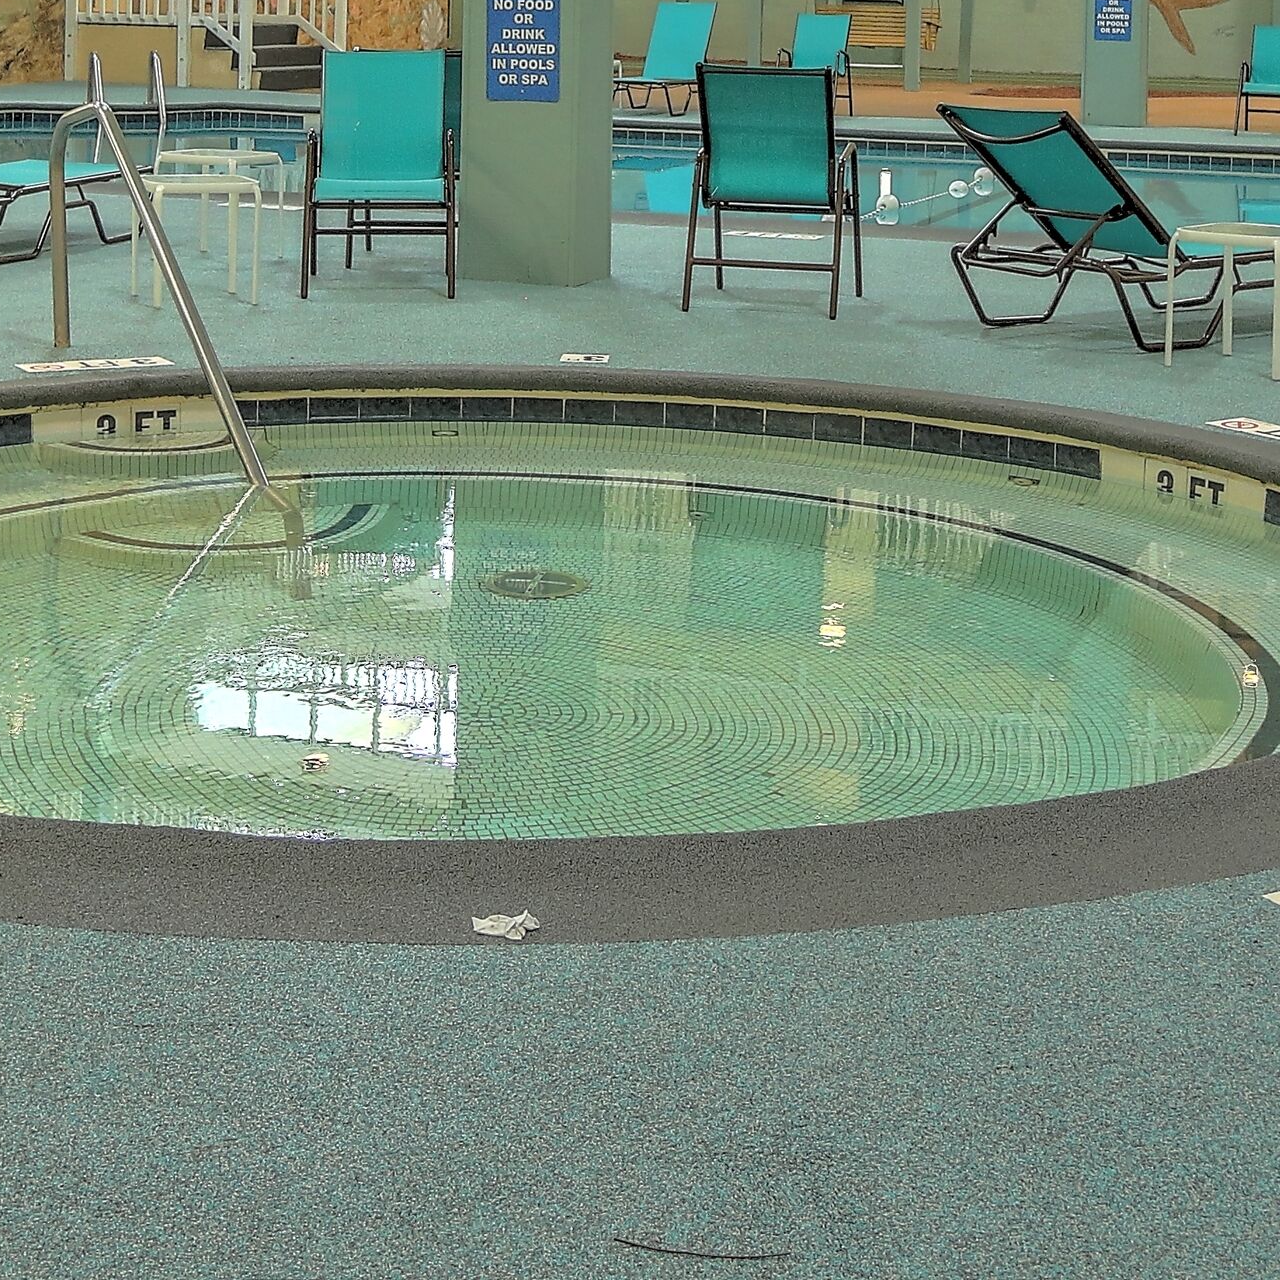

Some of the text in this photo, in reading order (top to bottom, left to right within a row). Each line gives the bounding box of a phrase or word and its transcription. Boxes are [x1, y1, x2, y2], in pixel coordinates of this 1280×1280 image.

[493, 0, 554, 11] NO FOOD
[1102, 6, 1125, 14] DRINK
[513, 13, 534, 25] OR
[1097, 13, 1130, 21] ALLOWED
[1106, 20, 1130, 28] POOLS
[502, 28, 546, 40] DRINK
[491, 43, 556, 55] ALLOWED
[492, 58, 556, 70] IN POOLS
[499, 73, 549, 86] OR SPA
[135, 409, 177, 433] FT
[1189, 475, 1225, 507] FT
